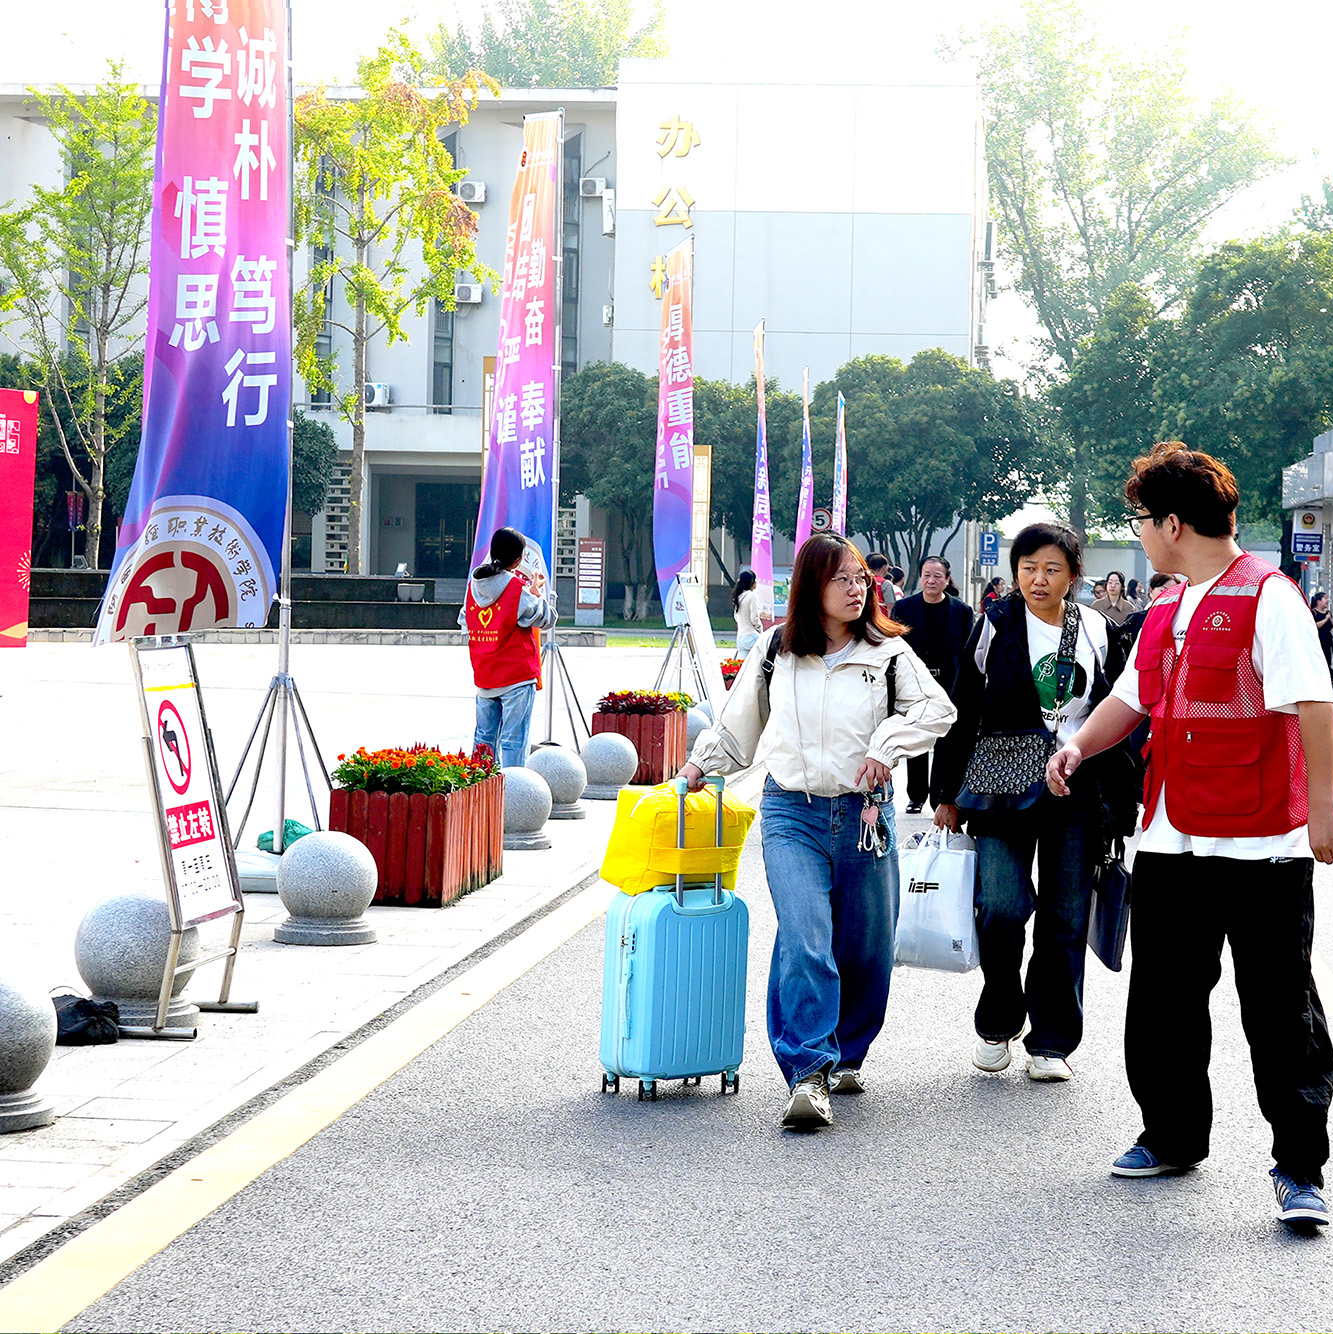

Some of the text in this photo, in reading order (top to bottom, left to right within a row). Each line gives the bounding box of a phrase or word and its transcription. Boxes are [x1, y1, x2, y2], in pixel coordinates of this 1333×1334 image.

[168, 175, 229, 354] 慎思
[221, 25, 279, 430] 诚朴 笃行
[984, 534, 995, 551] P
[167, 806, 213, 845] 禁止左转
